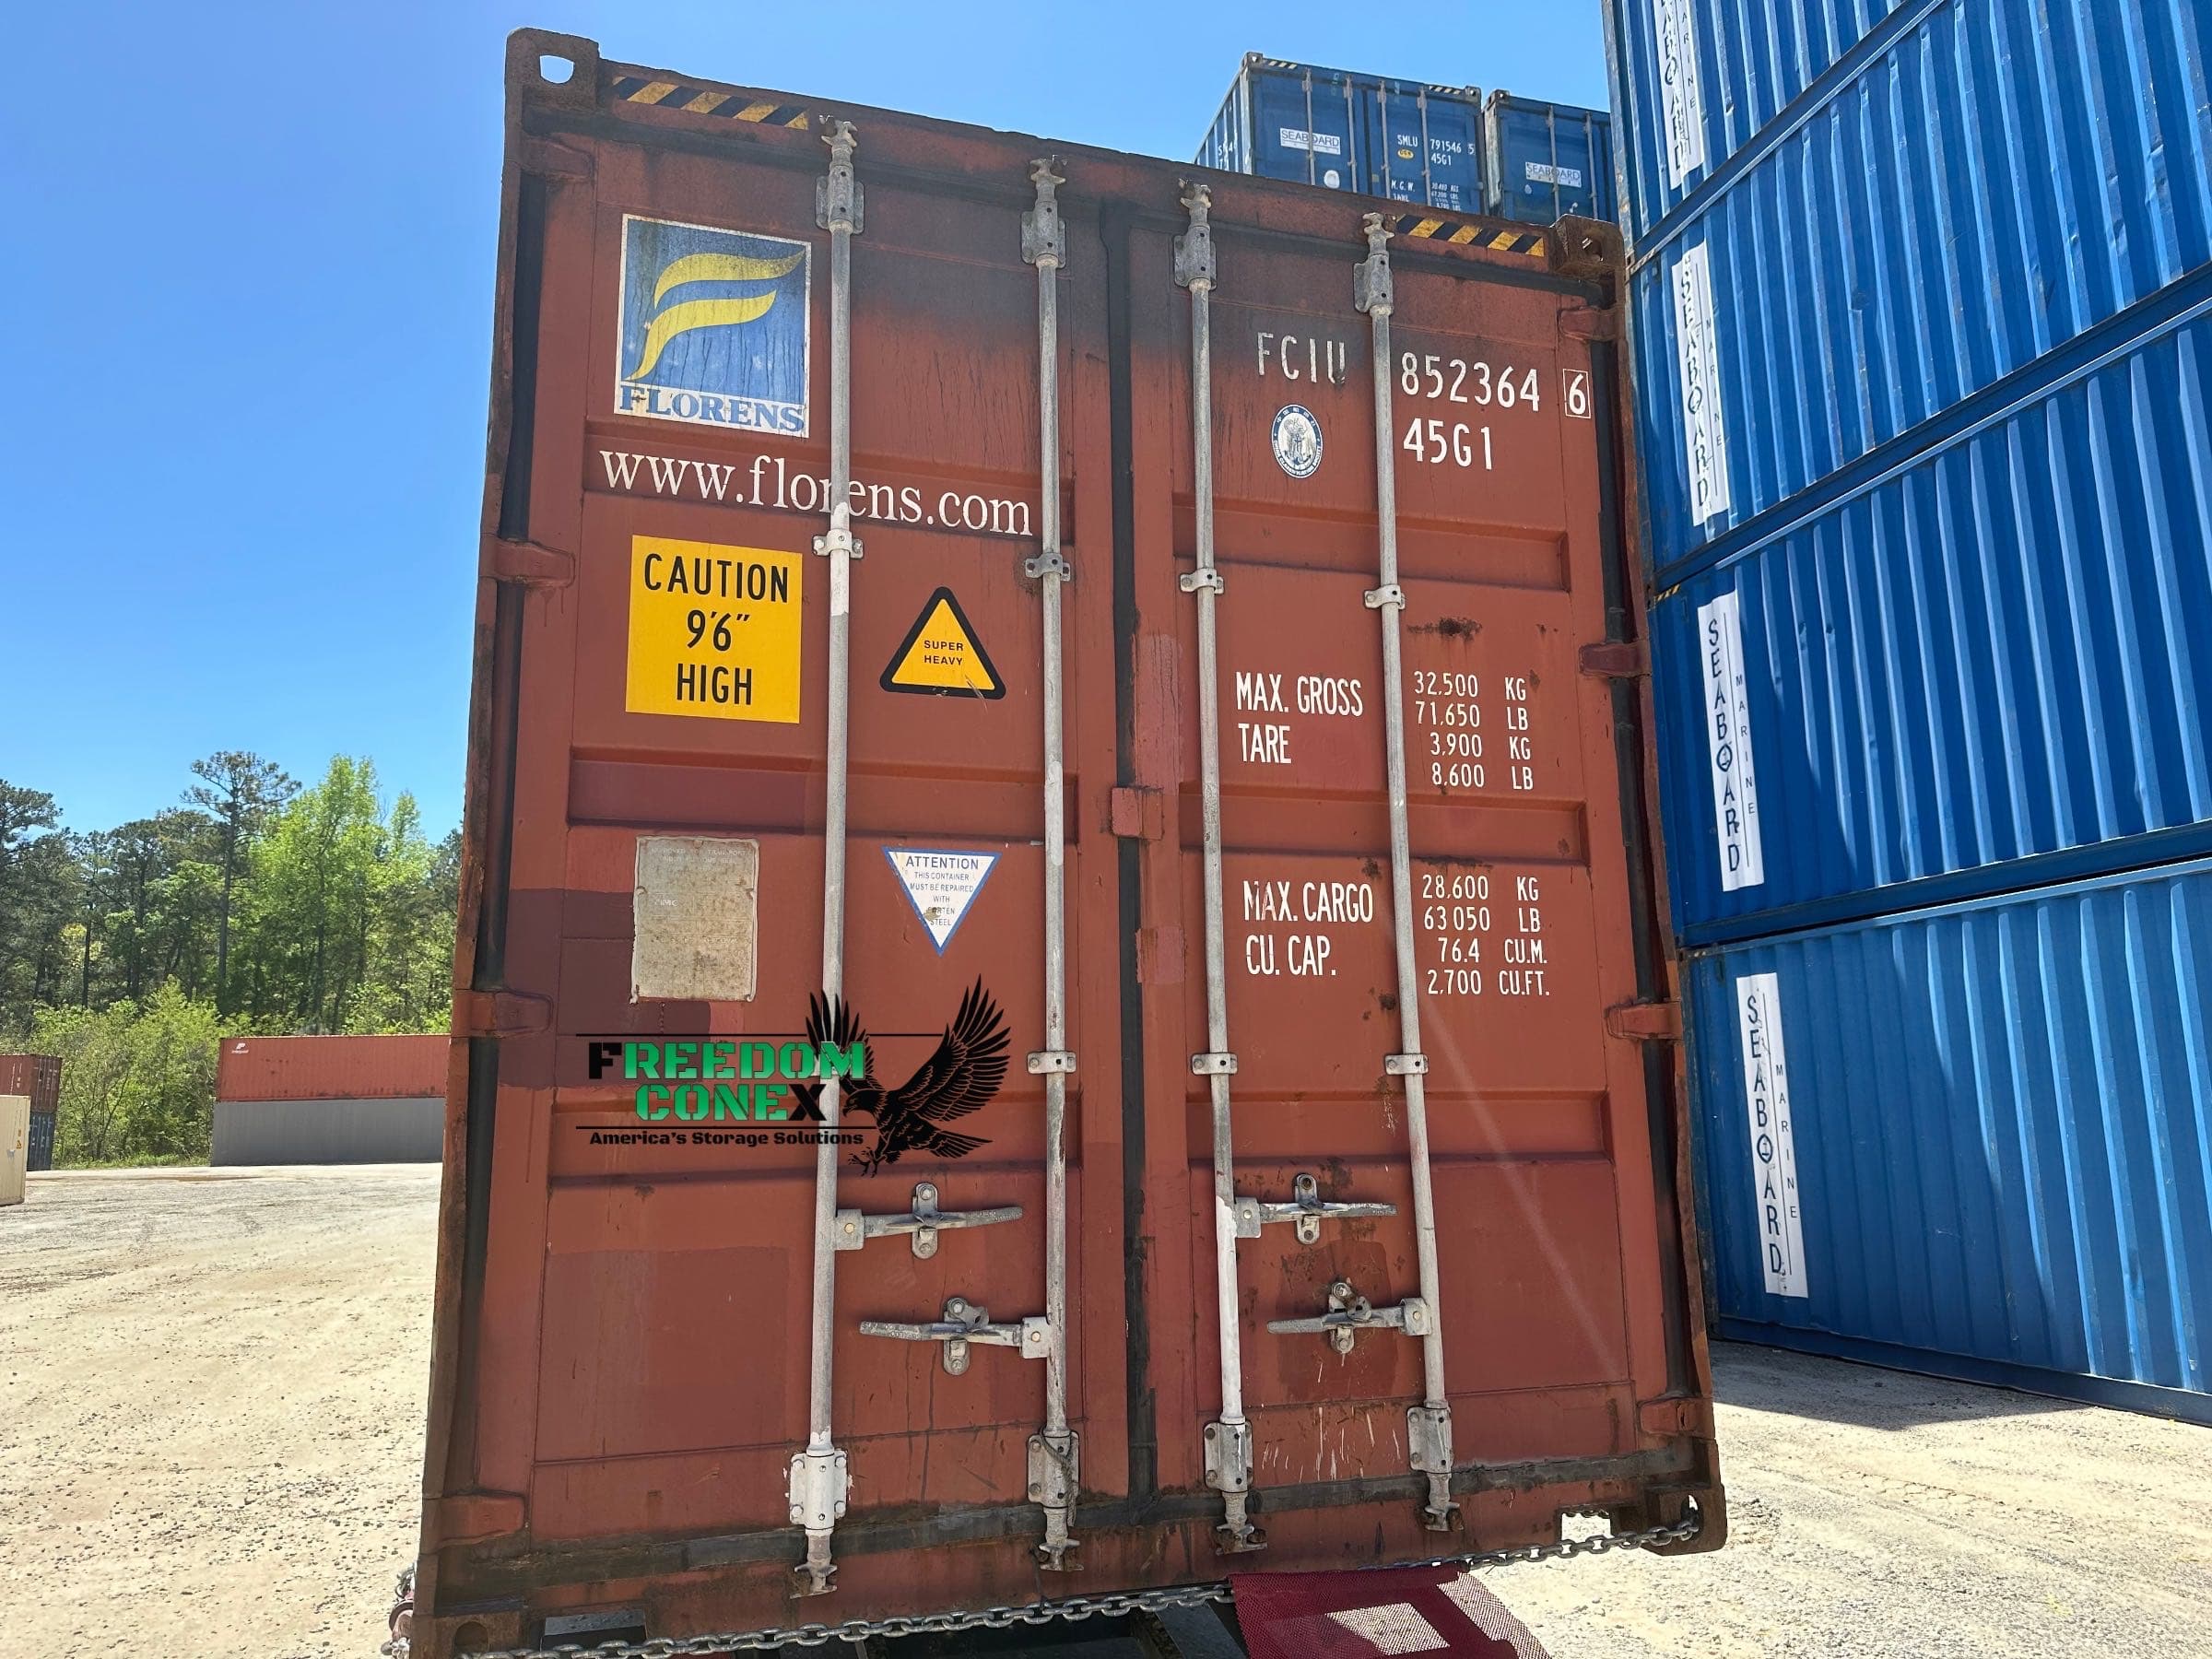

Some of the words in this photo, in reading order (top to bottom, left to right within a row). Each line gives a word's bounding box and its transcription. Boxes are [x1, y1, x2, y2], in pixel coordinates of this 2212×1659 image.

[1661, 0, 1689, 170] ABOARD
[1397, 135, 1418, 147] SMLU
[1430, 138, 1462, 153] 791546
[1468, 143, 1475, 155] 5
[1430, 152, 1452, 166] 45G1
[1257, 331, 1347, 384] FCIU
[1400, 350, 1541, 413] 852364
[1568, 371, 1587, 417] 6
[1680, 270, 1710, 507] SEABOARD
[618, 383, 806, 433] FLORENS
[1403, 418, 1493, 471] 45G1
[598, 450, 1033, 536] www.florens.com
[643, 553, 789, 604] CAUTION
[924, 639, 964, 652] SUPER
[924, 653, 964, 666] HEAVY
[676, 663, 753, 706] HIGH
[1235, 671, 1288, 712] MAX.
[1297, 676, 1364, 717] GROSS
[1505, 677, 1527, 701] KG
[1507, 707, 1529, 731] LB
[1238, 723, 1292, 764] TARE
[1509, 736, 1532, 760] KG
[1708, 618, 1741, 873] SEABOARD
[1735, 675, 1756, 816] MARINE
[1512, 766, 1535, 791] LB
[905, 855, 979, 869] ATTENTION
[914, 871, 930, 879] THIS
[931, 872, 969, 881] CONTAINER
[933, 895, 950, 903] WITH
[940, 884, 974, 893] REPAIRED
[1243, 880, 1299, 923] MAX.
[1302, 882, 1374, 924] CARGO
[1516, 877, 1540, 901] KG
[930, 918, 951, 926] STEEL
[1519, 907, 1542, 933] LB
[1246, 934, 1280, 975] CU.
[1288, 935, 1337, 976] CAP.
[1437, 936, 1480, 963] 76.4
[1504, 938, 1548, 964] CU.M.
[1747, 994, 1783, 1276] SEABOARD
[1775, 1064, 1797, 1218] MARINE
